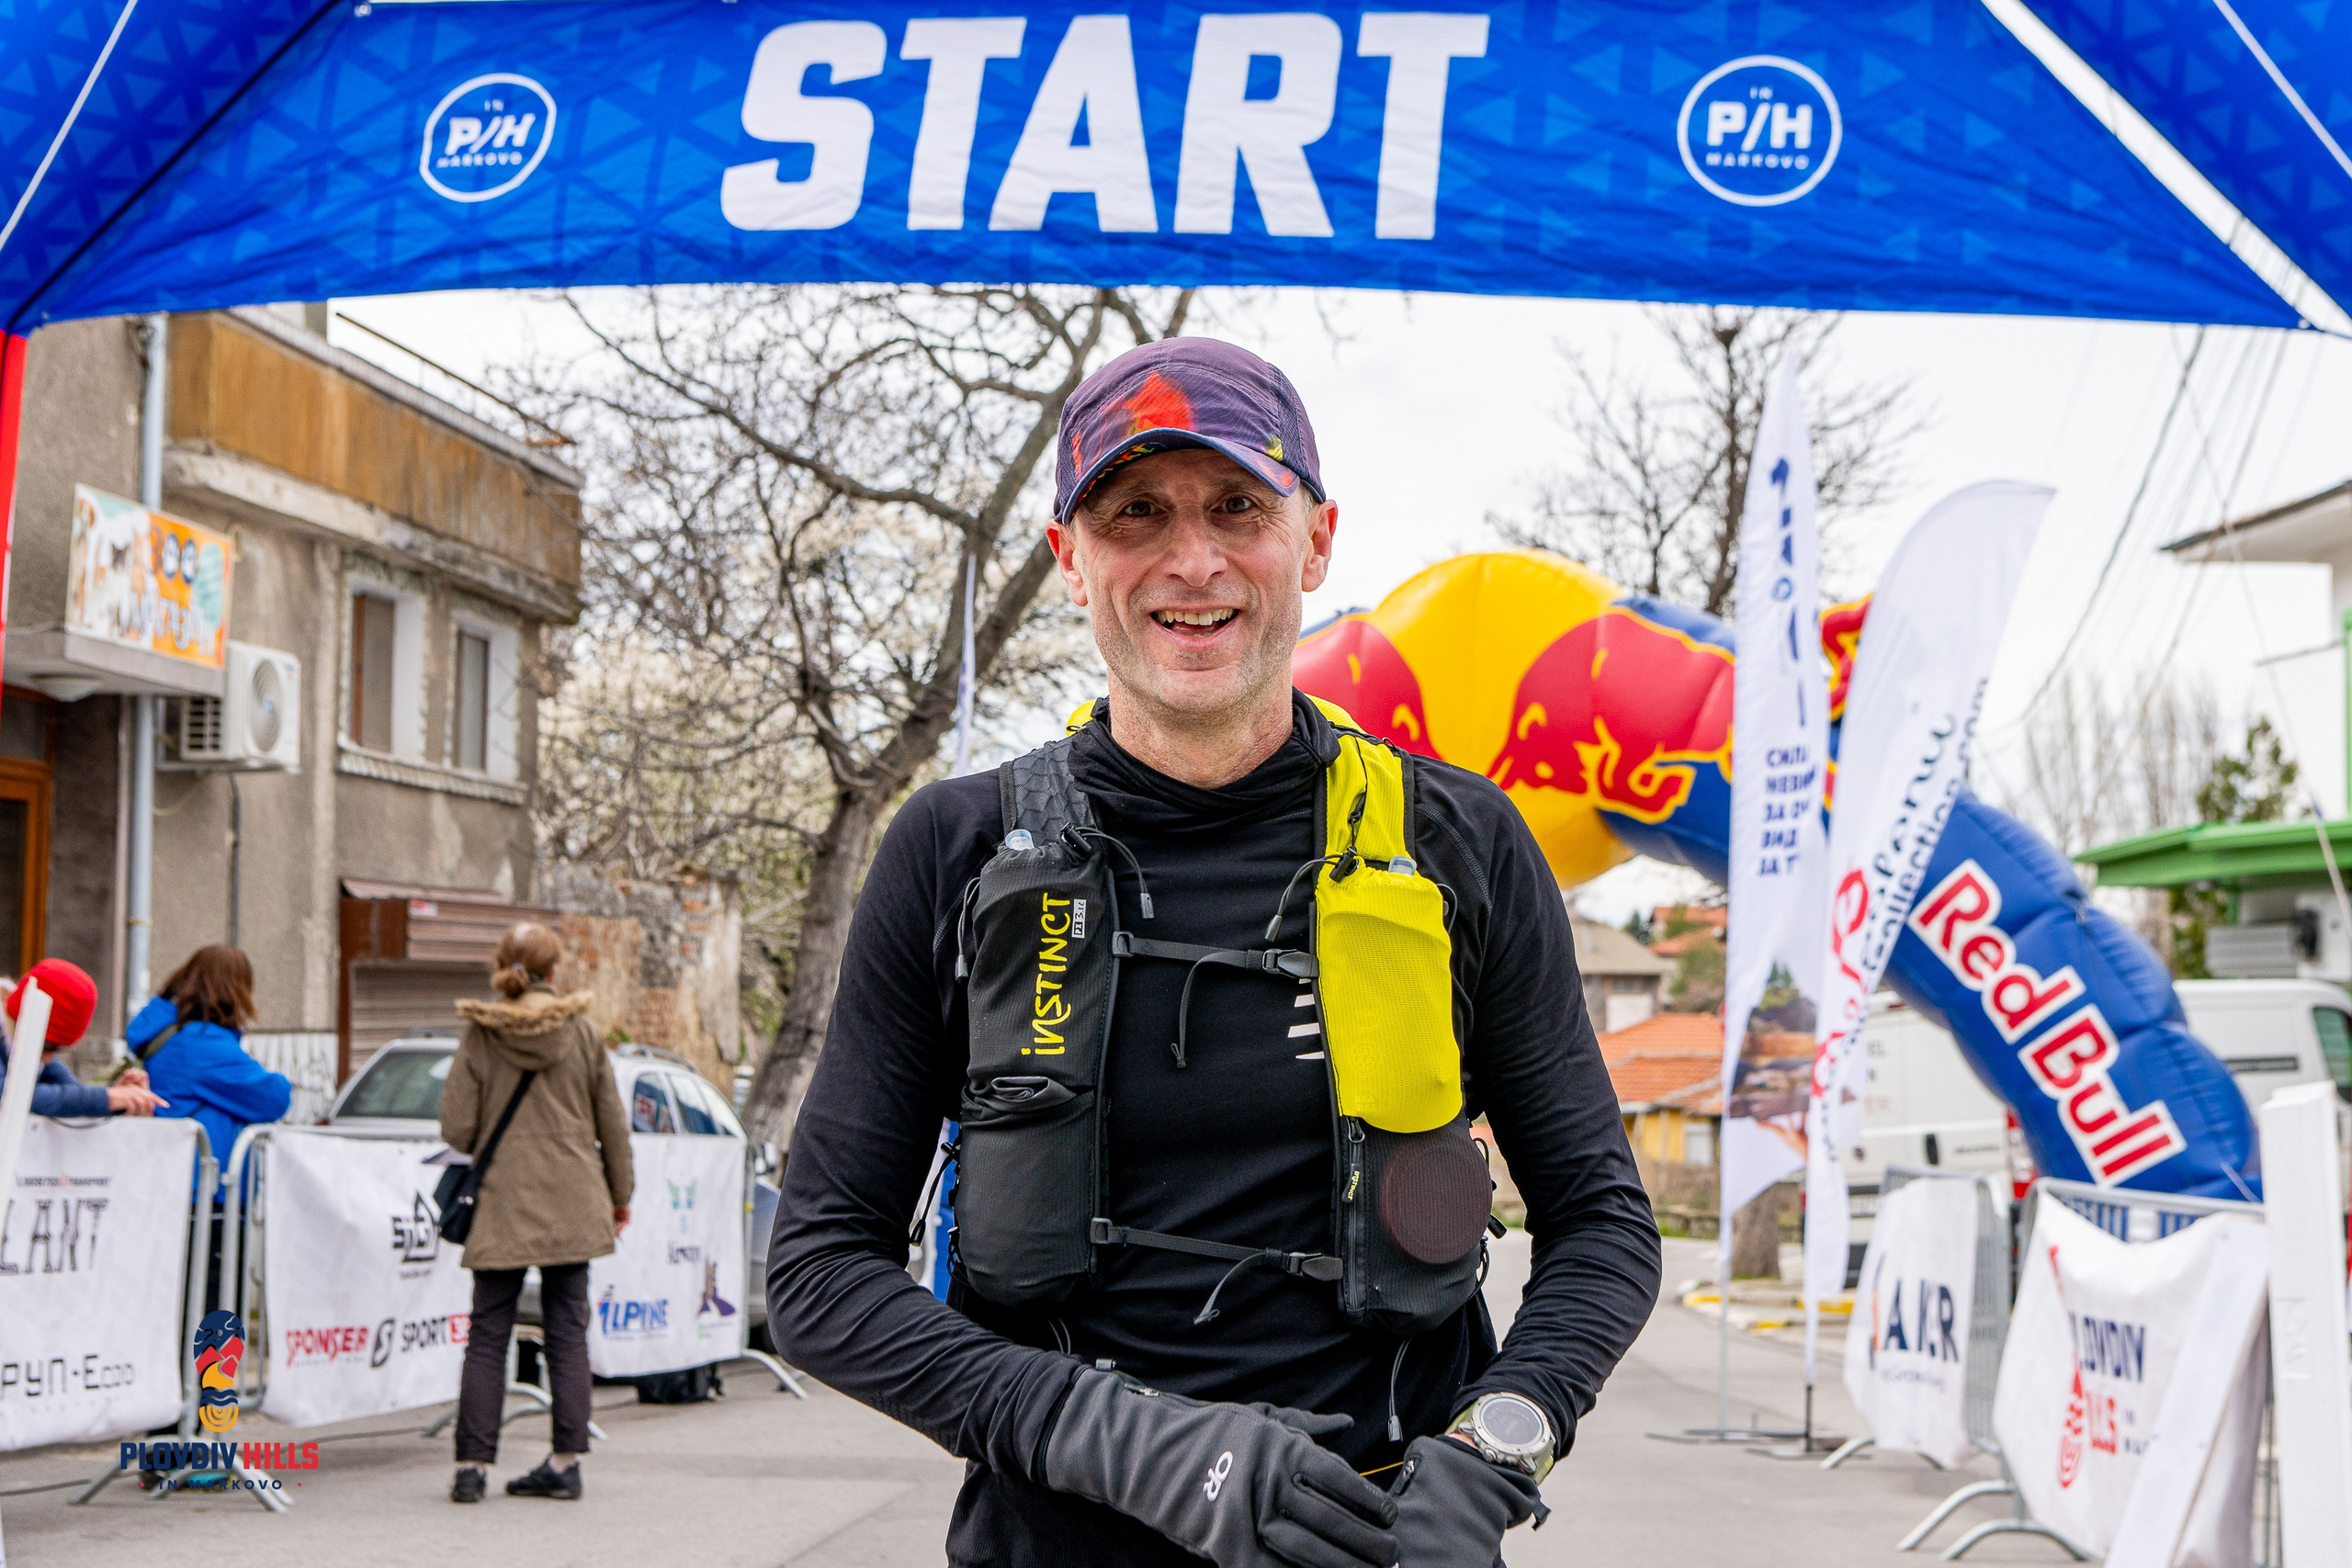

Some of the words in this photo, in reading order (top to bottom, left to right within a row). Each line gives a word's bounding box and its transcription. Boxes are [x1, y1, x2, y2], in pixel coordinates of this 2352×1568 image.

[445, 112, 536, 155] P/H
[720, 12, 1490, 240] START
[1706, 101, 1813, 152] P/H
[1915, 868, 2076, 1035] Red
[2027, 1012, 2177, 1181] Bull
